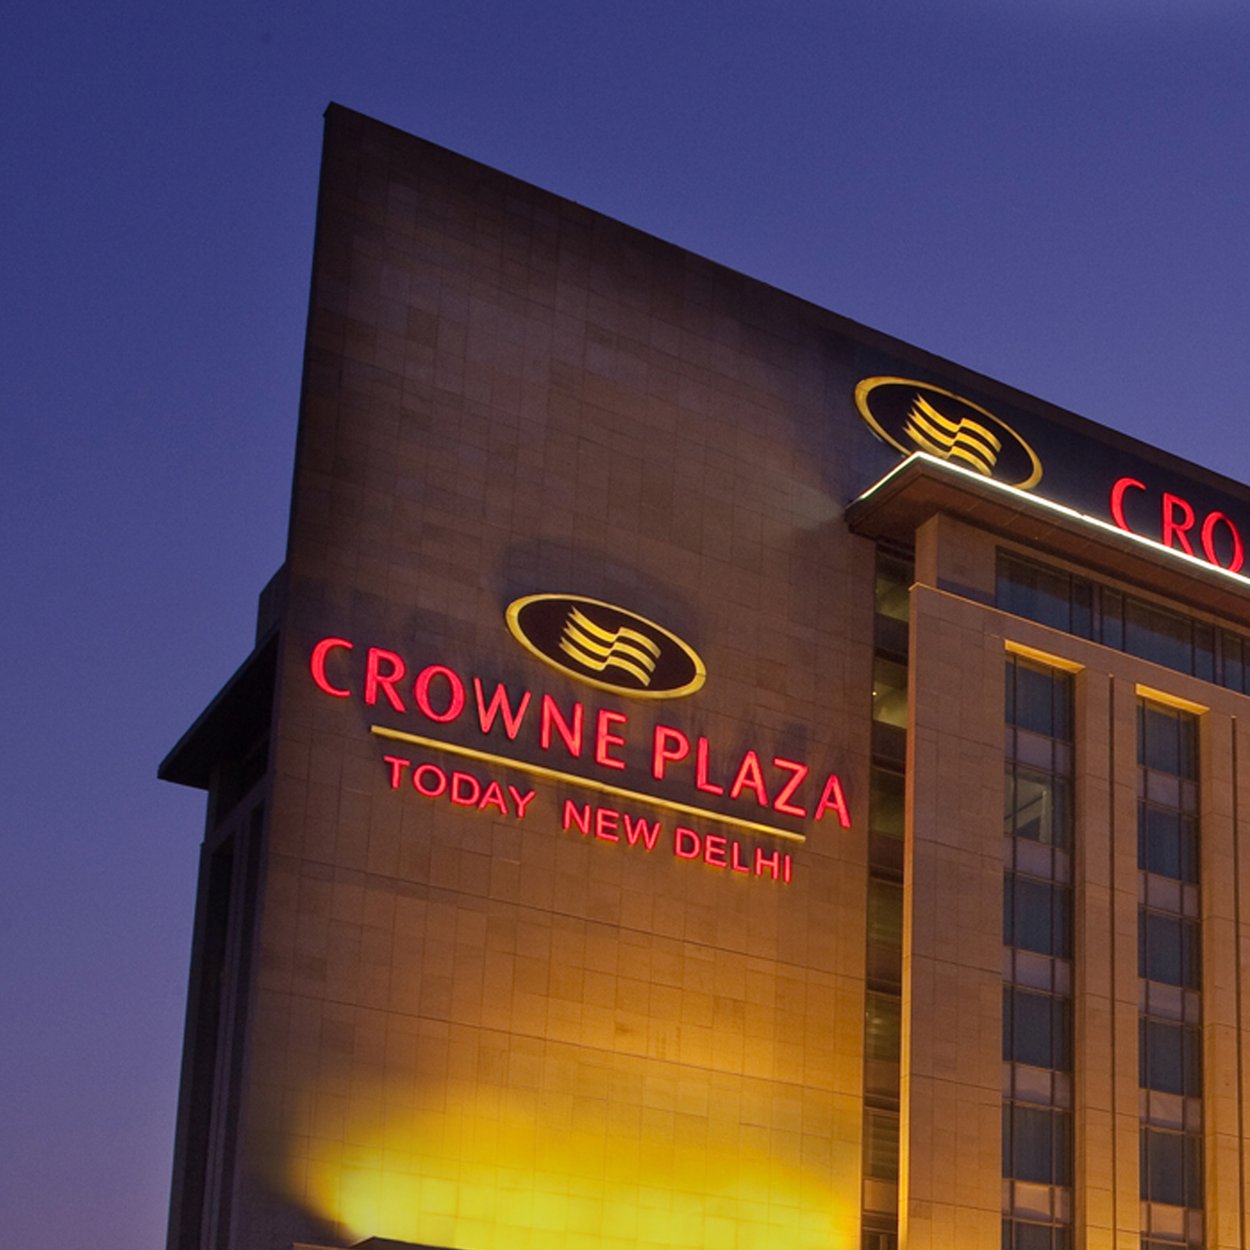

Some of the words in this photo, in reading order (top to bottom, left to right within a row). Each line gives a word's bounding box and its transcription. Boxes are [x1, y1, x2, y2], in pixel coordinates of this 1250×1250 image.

[309, 637, 630, 770] CROWNE
[652, 725, 853, 831] PLAZA
[383, 755, 538, 821] TODAY
[562, 799, 663, 854] NEW
[673, 826, 793, 885] DELHI
